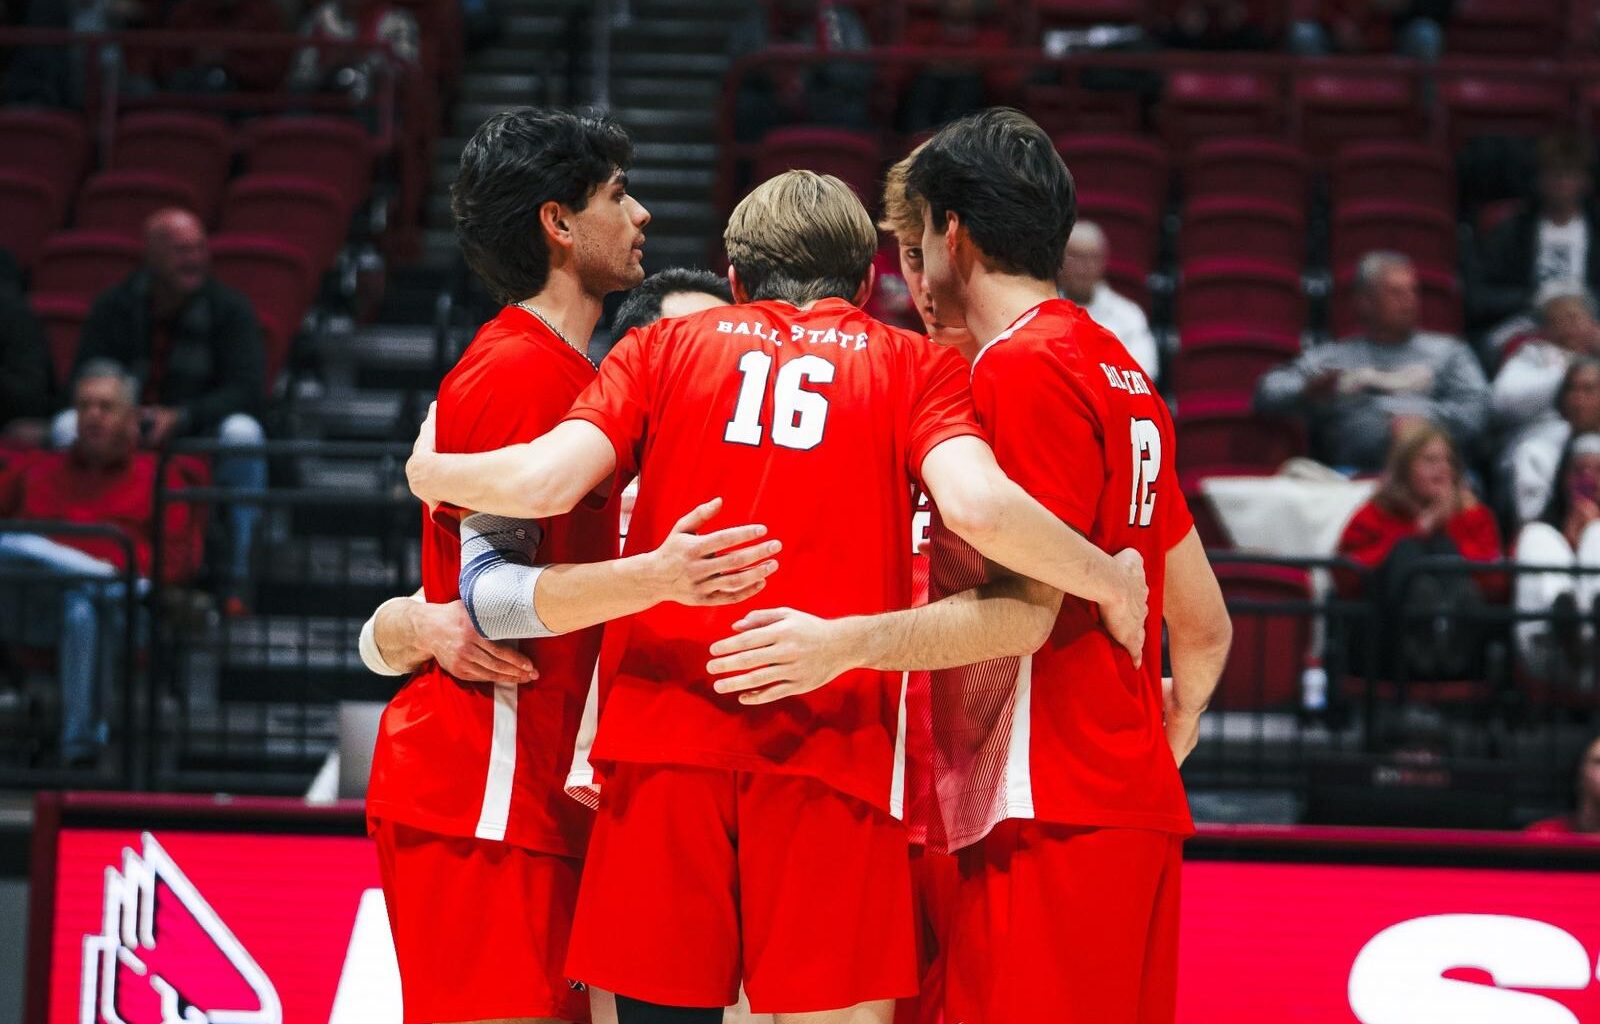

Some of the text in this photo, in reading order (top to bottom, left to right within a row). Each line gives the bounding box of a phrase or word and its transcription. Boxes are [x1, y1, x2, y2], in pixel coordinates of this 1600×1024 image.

[716, 320, 869, 351] BALL STATE
[722, 349, 836, 452] 16
[1128, 416, 1162, 528] 12
[1347, 913, 1600, 1024] S
